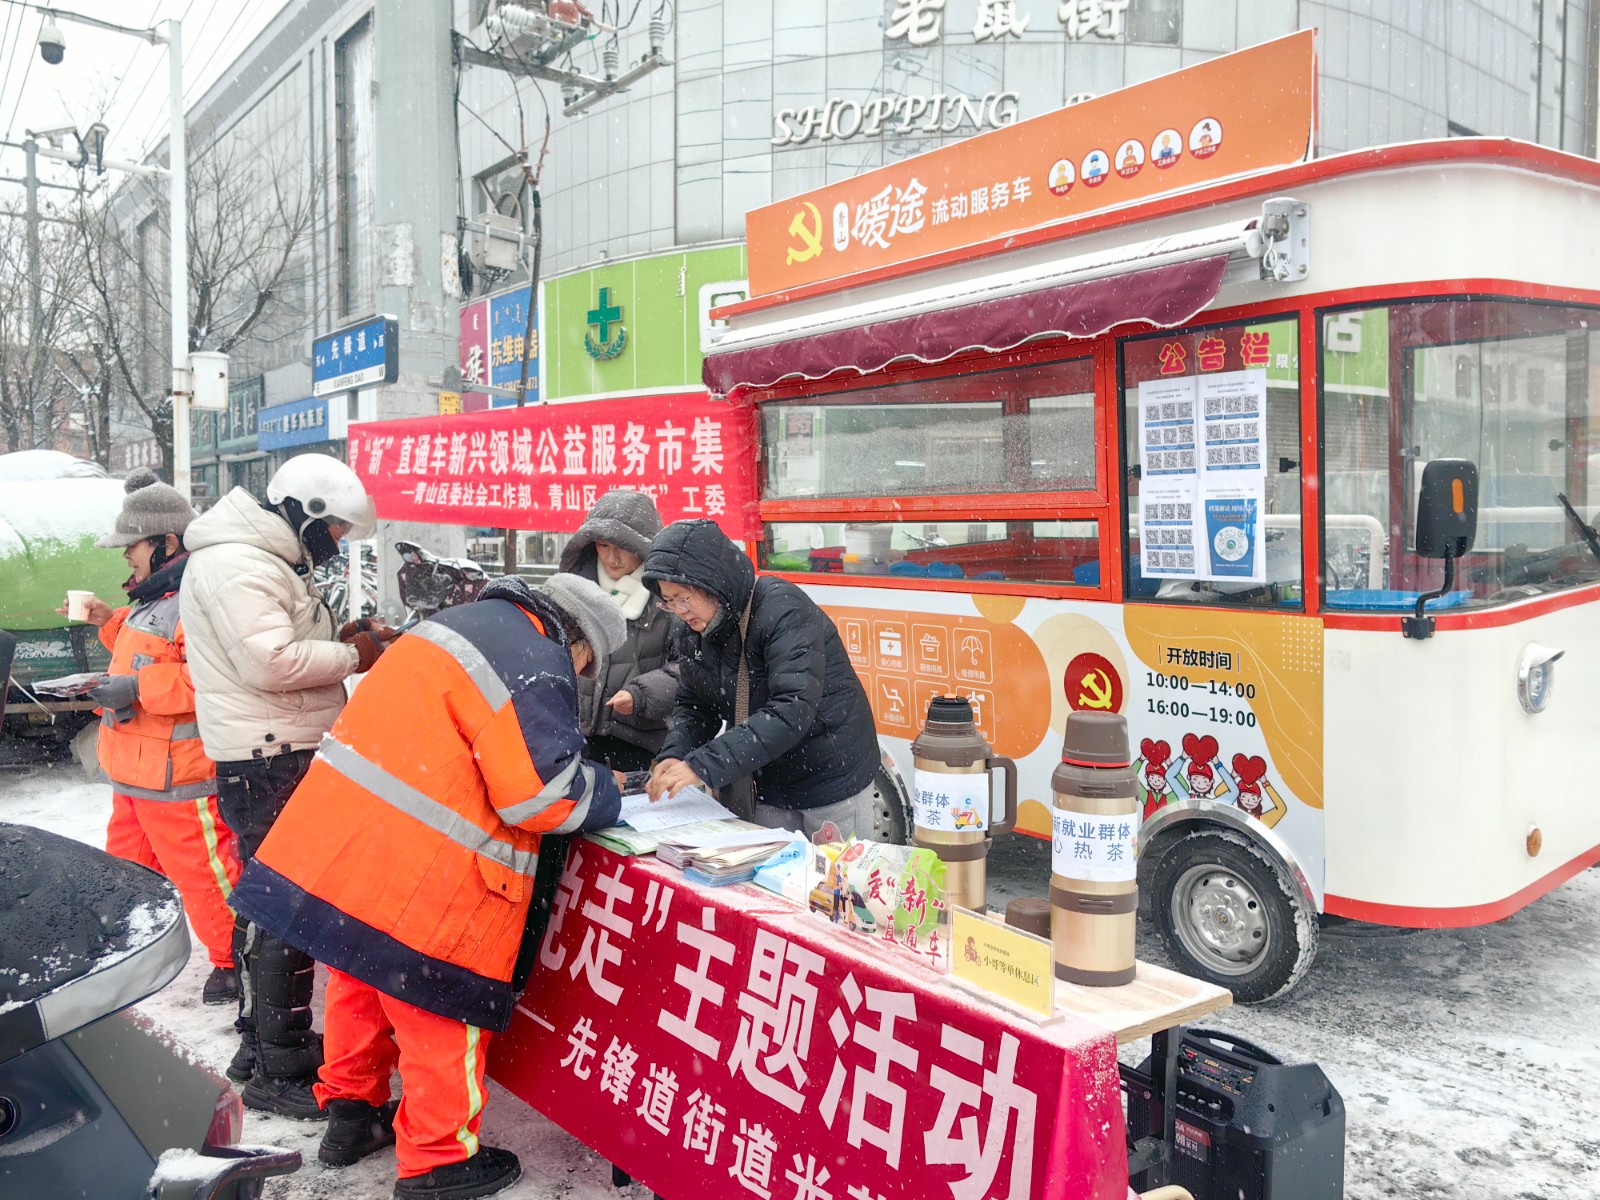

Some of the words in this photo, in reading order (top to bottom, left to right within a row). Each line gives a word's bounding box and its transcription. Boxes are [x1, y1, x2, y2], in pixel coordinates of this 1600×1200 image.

[771, 90, 1019, 146] SHOPPING
[851, 177, 928, 249] 暖途
[931, 176, 1033, 226] 流动服务车
[331, 330, 367, 360] 先锋道
[1159, 332, 1271, 375] 公告栏
[1166, 647, 1232, 671] 开放时间
[882, 913, 942, 967] 直通车
